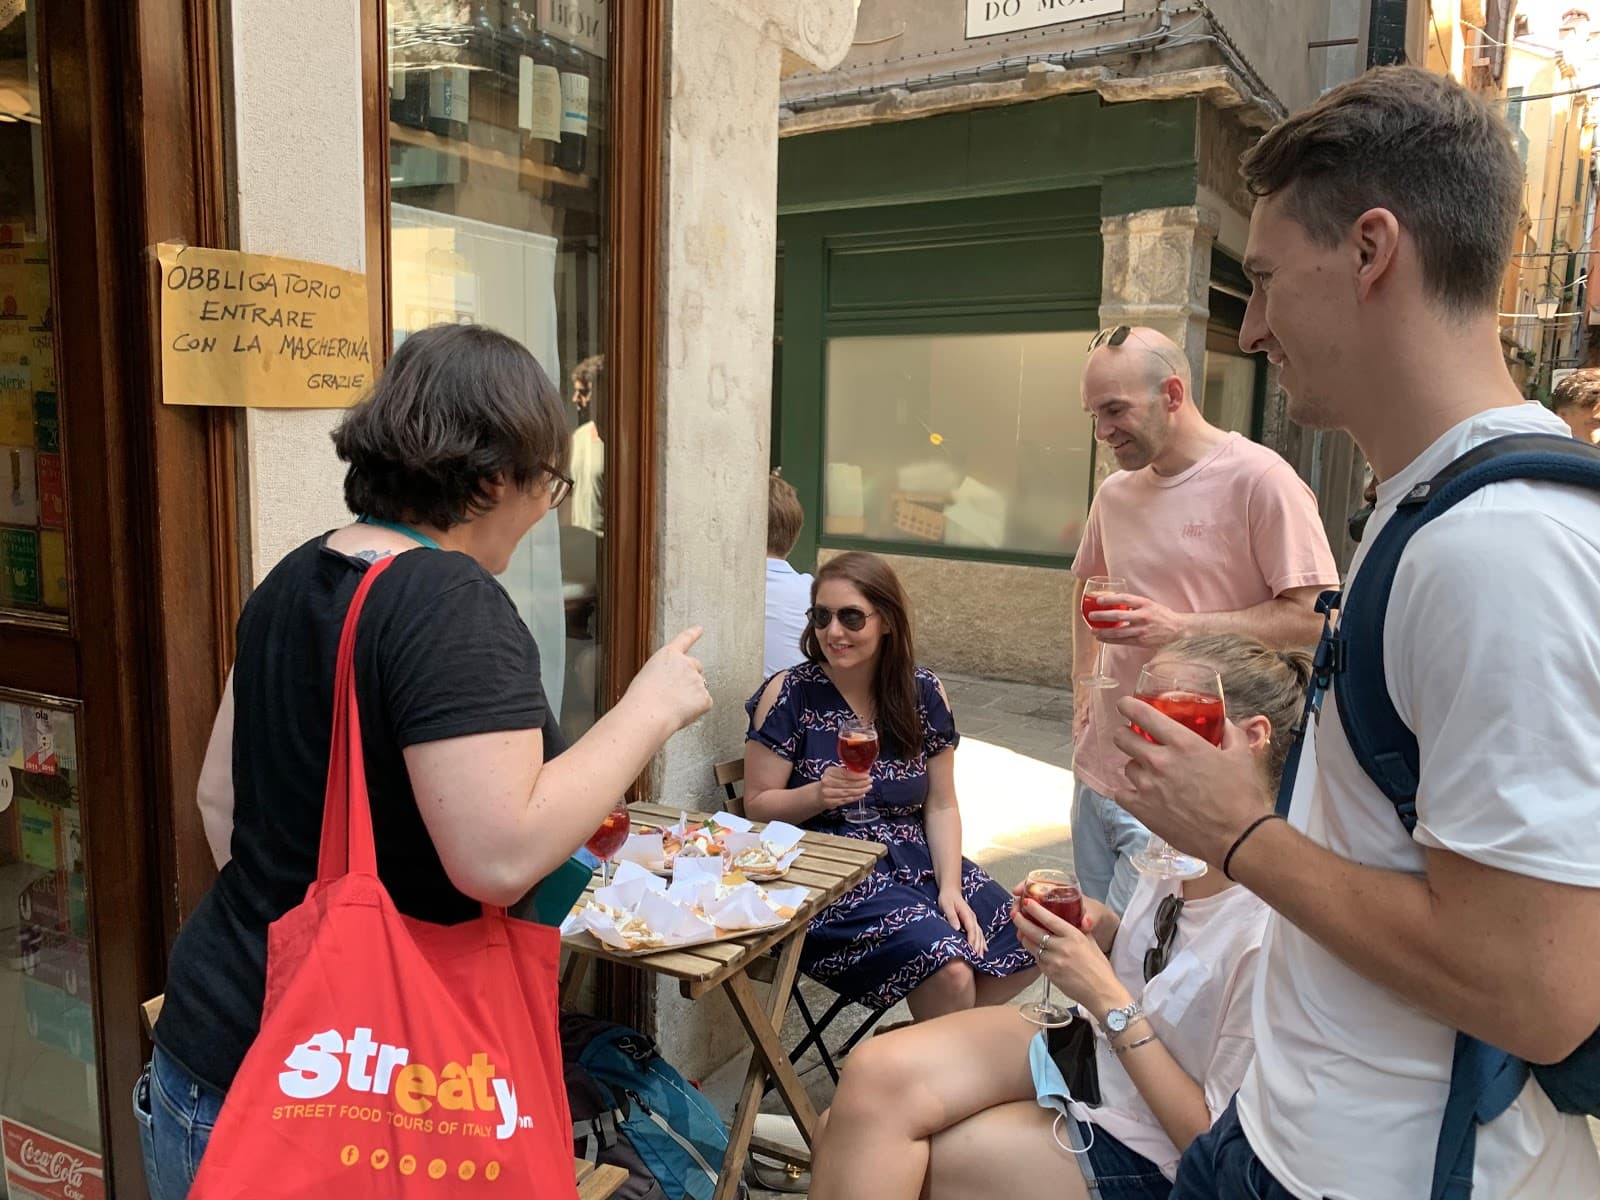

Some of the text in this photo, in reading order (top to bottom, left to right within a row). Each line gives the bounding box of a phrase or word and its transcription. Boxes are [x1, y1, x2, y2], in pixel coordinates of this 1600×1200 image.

[985, 0, 1021, 21] DO
[167, 265, 341, 299] OBBLIGATORIO
[200, 300, 317, 329] ENTRARE
[172, 333, 370, 364] CON LA MASCHERINA
[307, 373, 365, 390] GRAZIE
[272, 1104, 492, 1139] STREET FOOD TOURS OF ITALY
[20, 1138, 84, 1188] Coca-Cola
